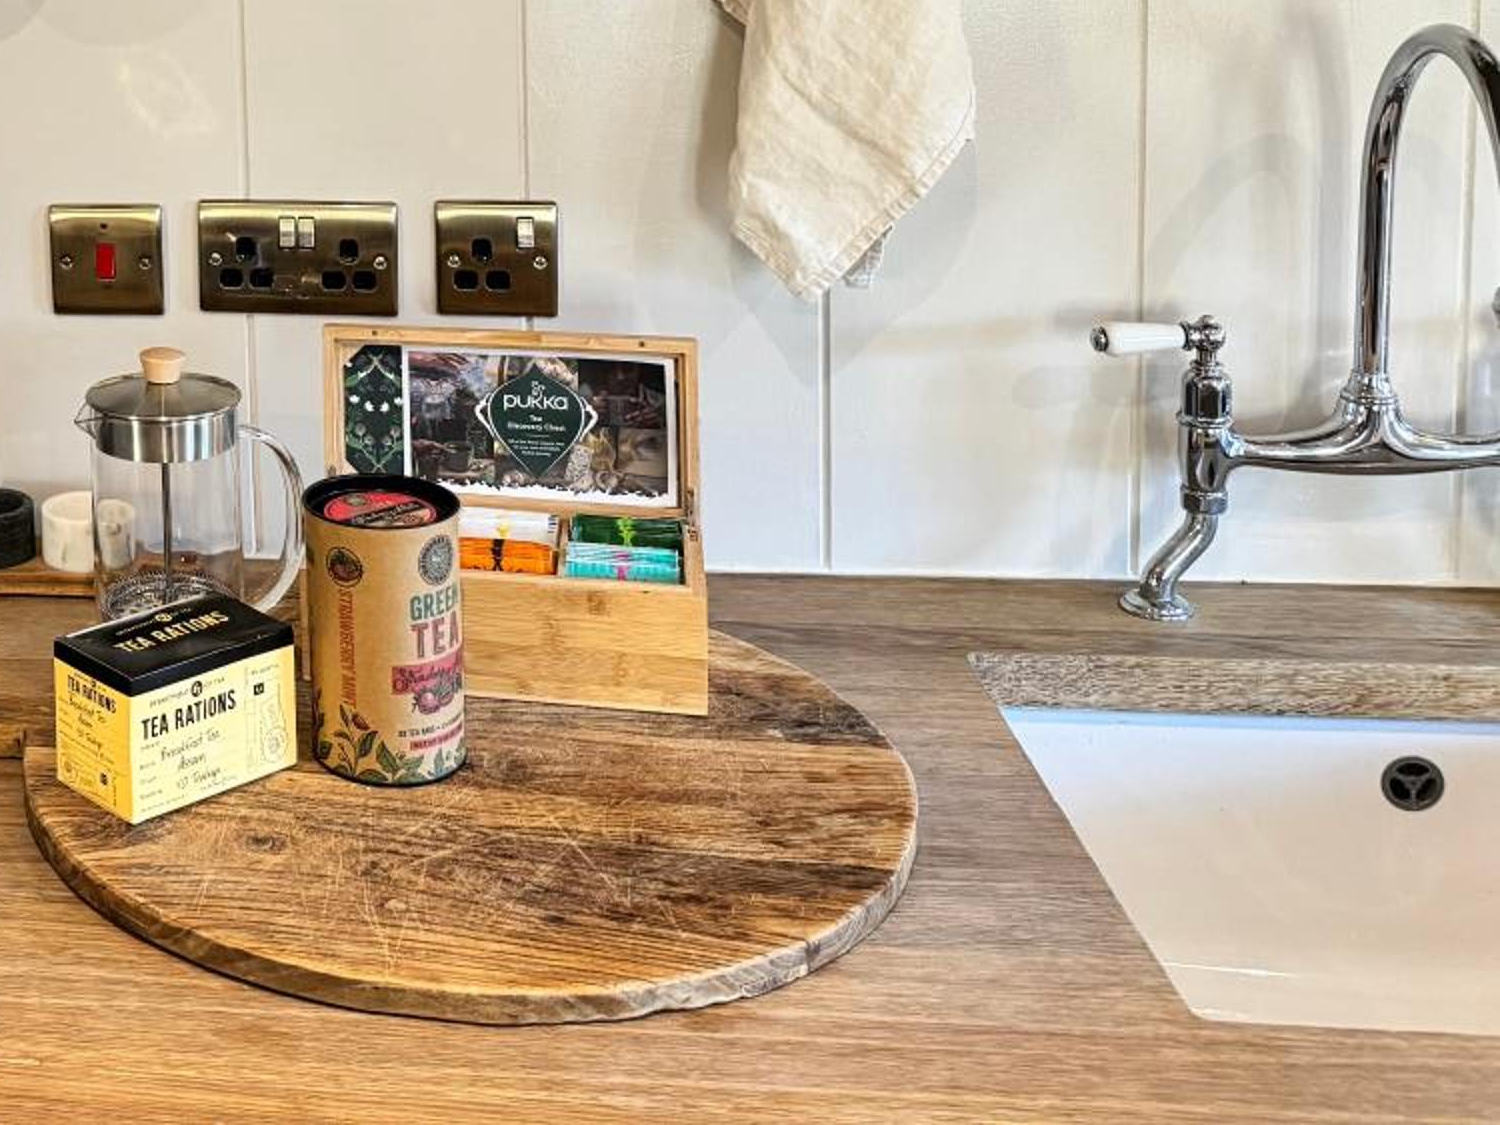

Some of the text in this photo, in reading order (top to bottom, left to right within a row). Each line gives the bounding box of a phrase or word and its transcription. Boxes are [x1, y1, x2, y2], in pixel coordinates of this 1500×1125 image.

[112, 636, 156, 654] TEA
[151, 609, 230, 643] RATIONS
[411, 610, 460, 658] TEA
[141, 713, 169, 741] TEA
[175, 689, 237, 730] RATIONS
